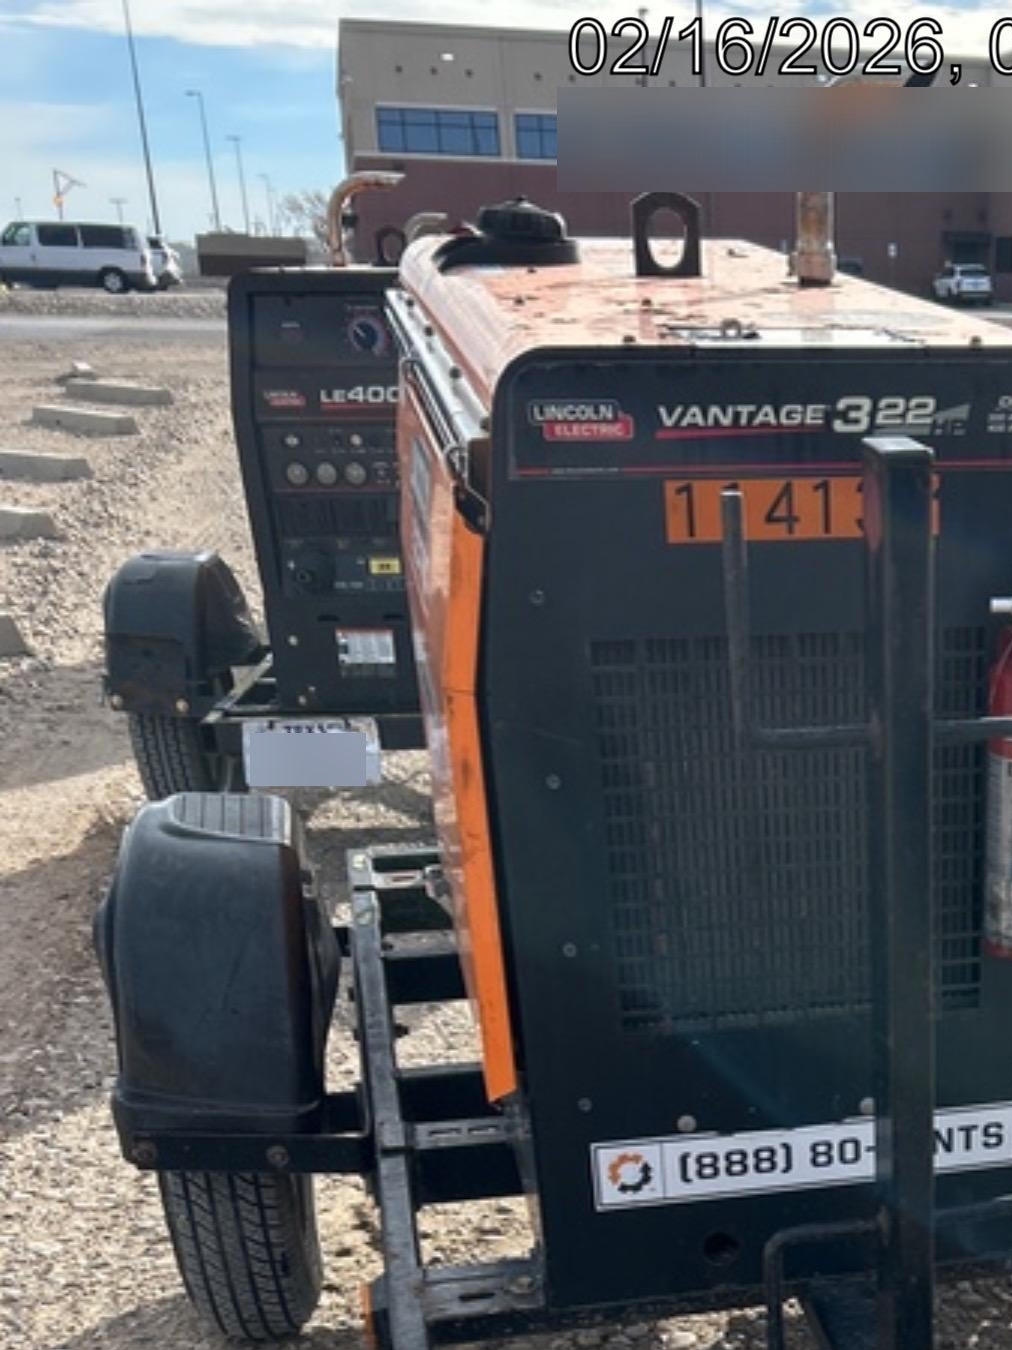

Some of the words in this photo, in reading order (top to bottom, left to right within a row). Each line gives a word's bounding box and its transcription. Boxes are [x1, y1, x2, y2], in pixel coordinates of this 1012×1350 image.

[533, 404, 614, 420] LINCOLN
[659, 404, 827, 427] VANTAGE
[833, 396, 937, 433] 322
[553, 422, 626, 437] ELECTRIC
[680, 1142, 793, 1183] (888)
